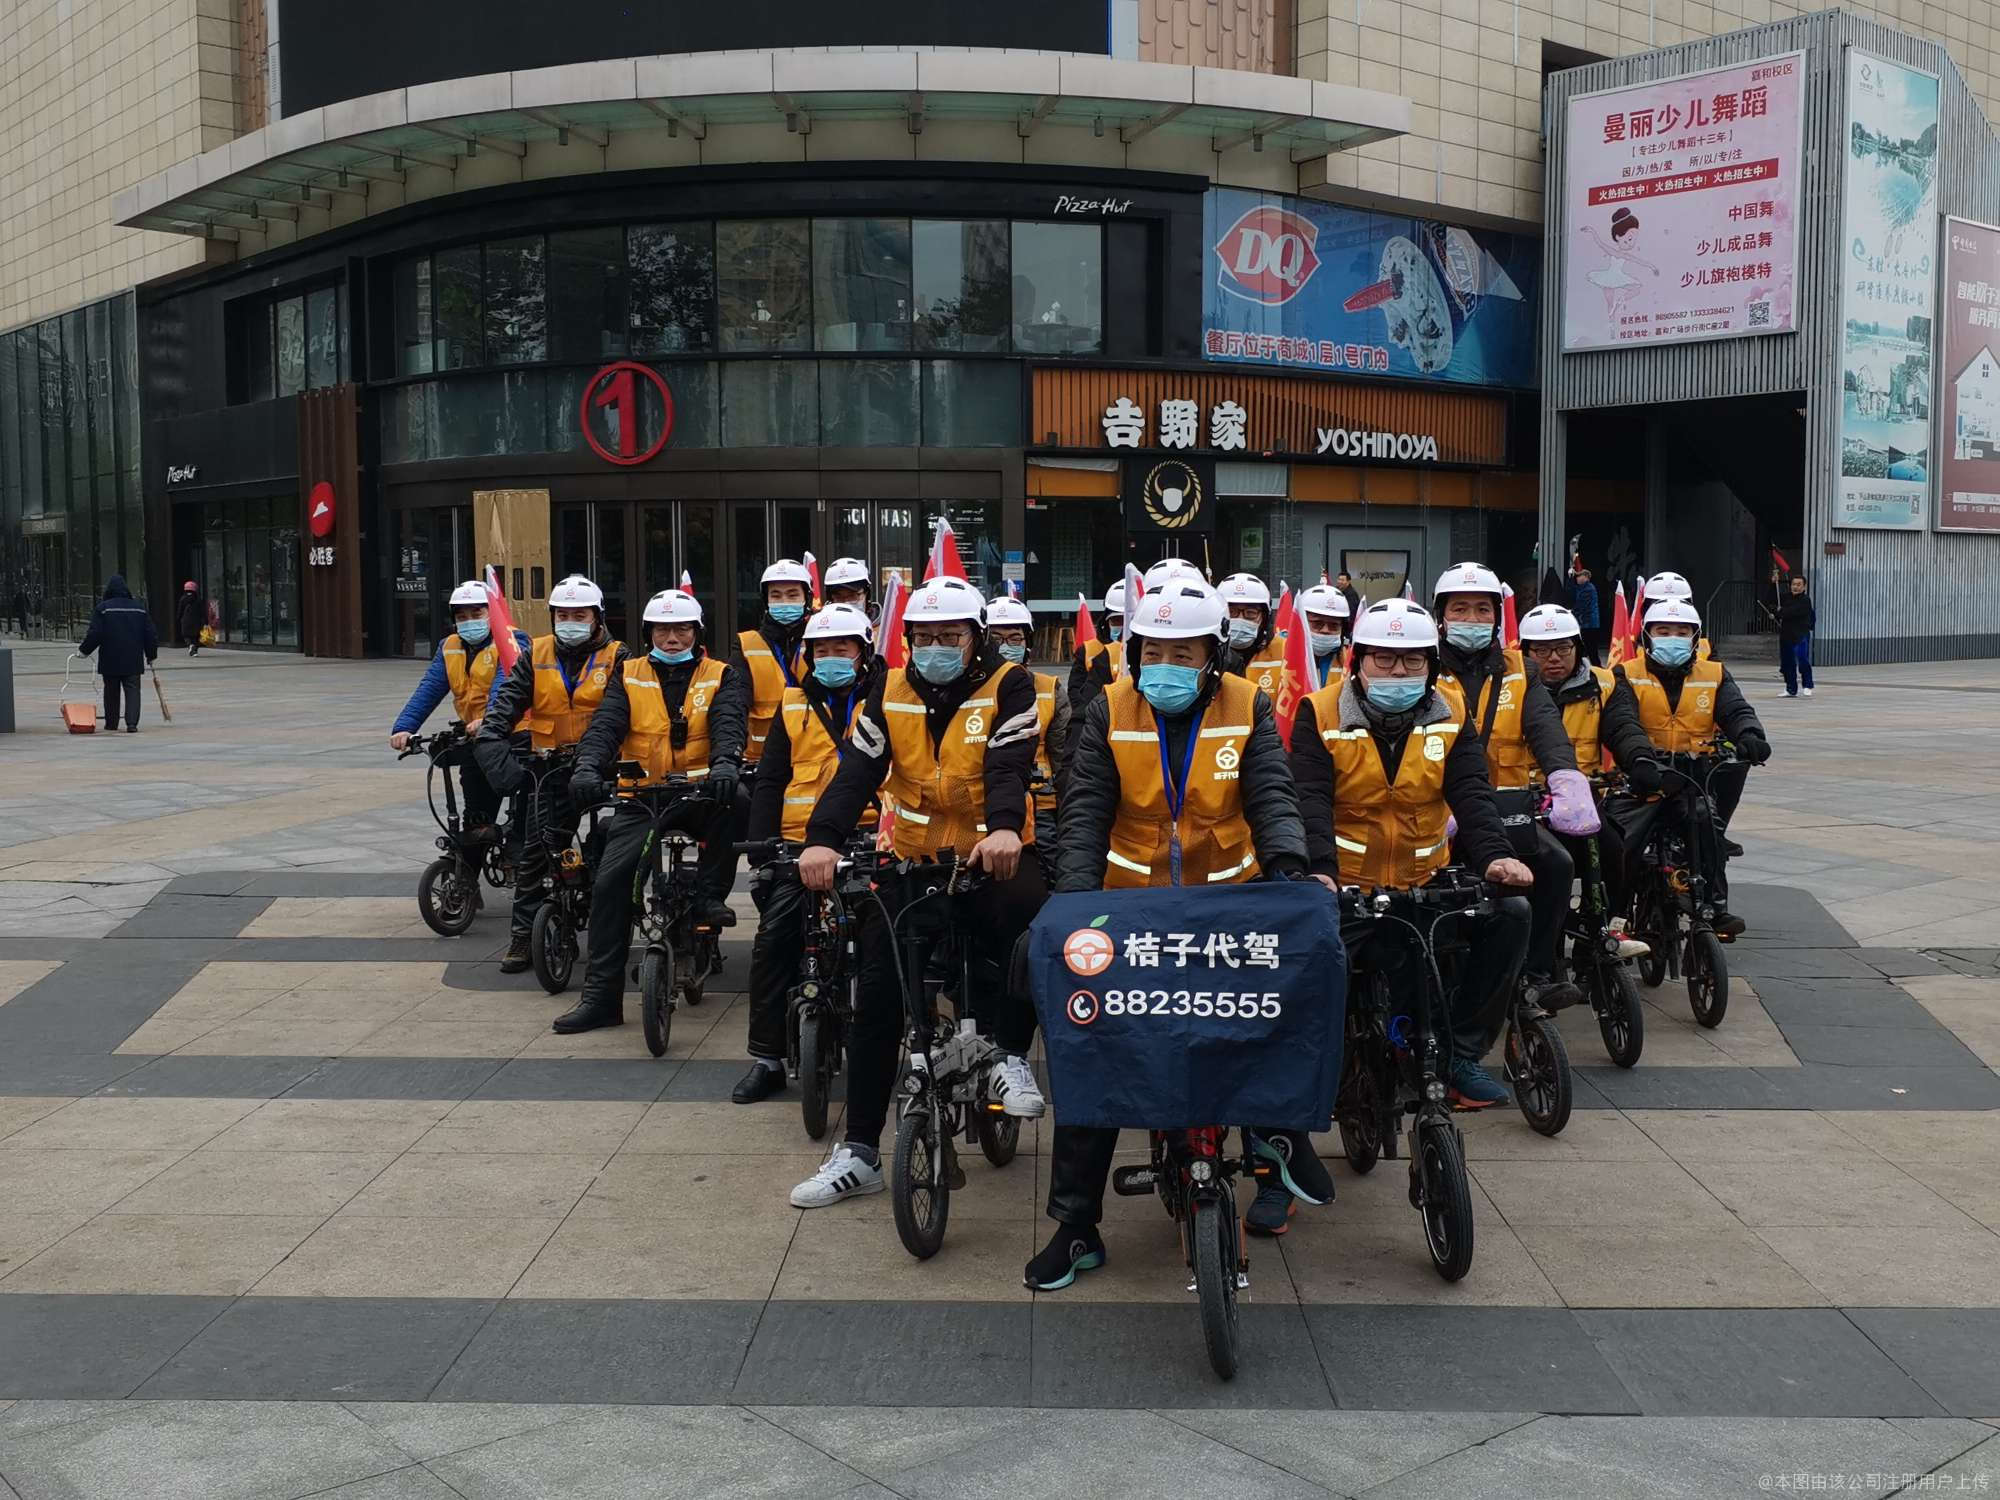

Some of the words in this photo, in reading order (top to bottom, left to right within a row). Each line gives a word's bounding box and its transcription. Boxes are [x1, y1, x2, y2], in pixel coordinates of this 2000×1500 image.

[1602, 85, 1768, 144] 曼丽少儿舞蹈
[1053, 195, 1100, 214] Pizza
[1101, 197, 1134, 215] Hut
[1728, 200, 1774, 222] 中国舞
[1233, 227, 1305, 287] DQ
[1696, 231, 1773, 256] 少儿成品舞
[1681, 262, 1773, 288] 少儿旗袍模特
[1205, 329, 1389, 370] 餐厅位于商城1层1号门内
[1102, 397, 1248, 451] 吉野家
[1317, 427, 1438, 462] YOSHINOYA
[309, 547, 335, 566] 必胜客
[1122, 931, 1280, 969] 桔子代驾
[1104, 989, 1282, 1019] 88235555
